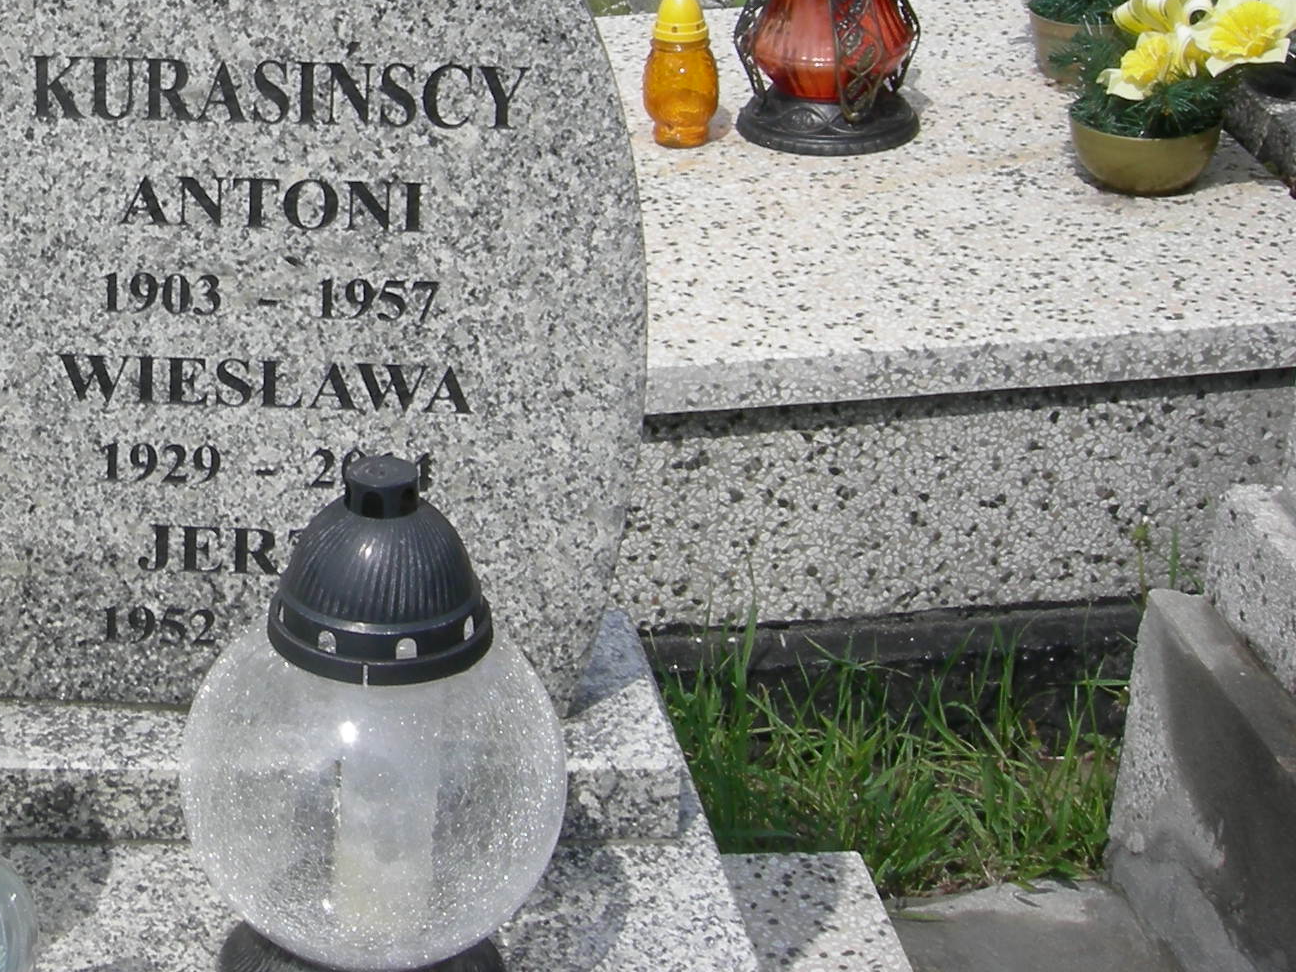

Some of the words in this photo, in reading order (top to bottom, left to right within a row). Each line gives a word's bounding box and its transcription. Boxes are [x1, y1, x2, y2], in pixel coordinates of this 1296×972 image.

[32, 42, 530, 129] KURASIŃSCY
[119, 175, 428, 232] ANTONI
[104, 272, 222, 317] 1903
[319, 278, 441, 323] 1957
[59, 353, 475, 415] WIESŁAWA
[104, 442, 222, 485] 1929
[138, 523, 306, 576] JER
[104, 605, 216, 646] 1952
